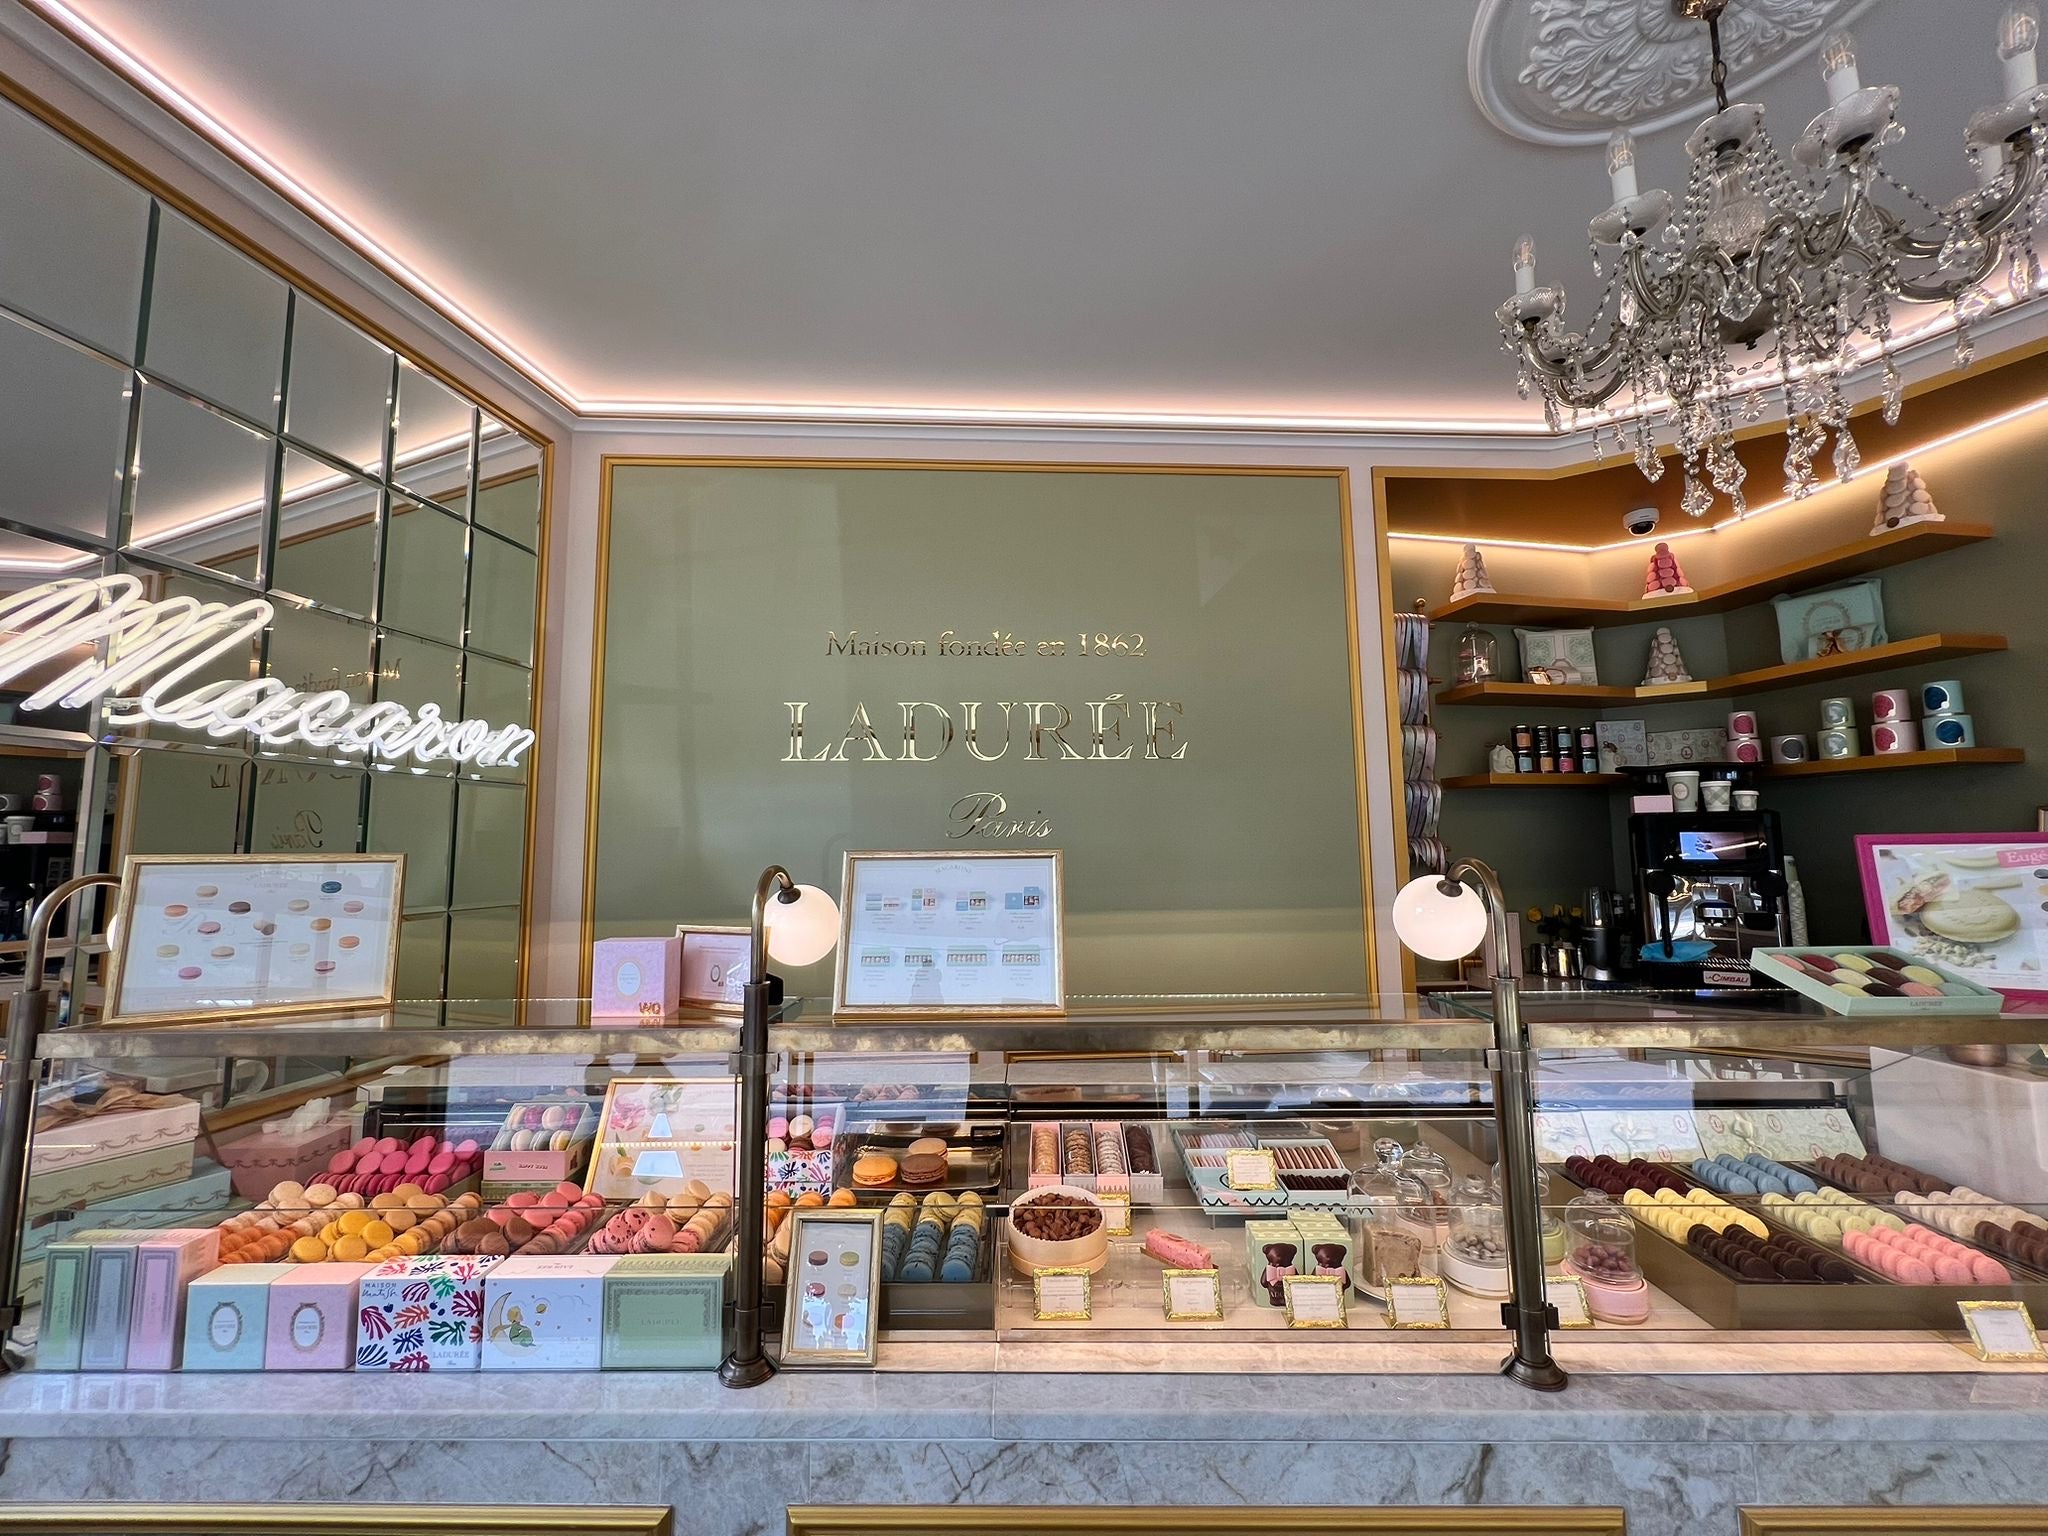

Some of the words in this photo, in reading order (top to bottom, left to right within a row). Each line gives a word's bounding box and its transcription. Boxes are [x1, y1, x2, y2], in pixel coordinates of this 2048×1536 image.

[0, 573, 535, 769] Macaron
[825, 630, 928, 657] Maison
[938, 629, 1026, 657] fondée
[1037, 639, 1067, 657] en
[1077, 632, 1149, 657] 1862
[781, 693, 1190, 762] LADURÉE
[945, 791, 1055, 840] Paris
